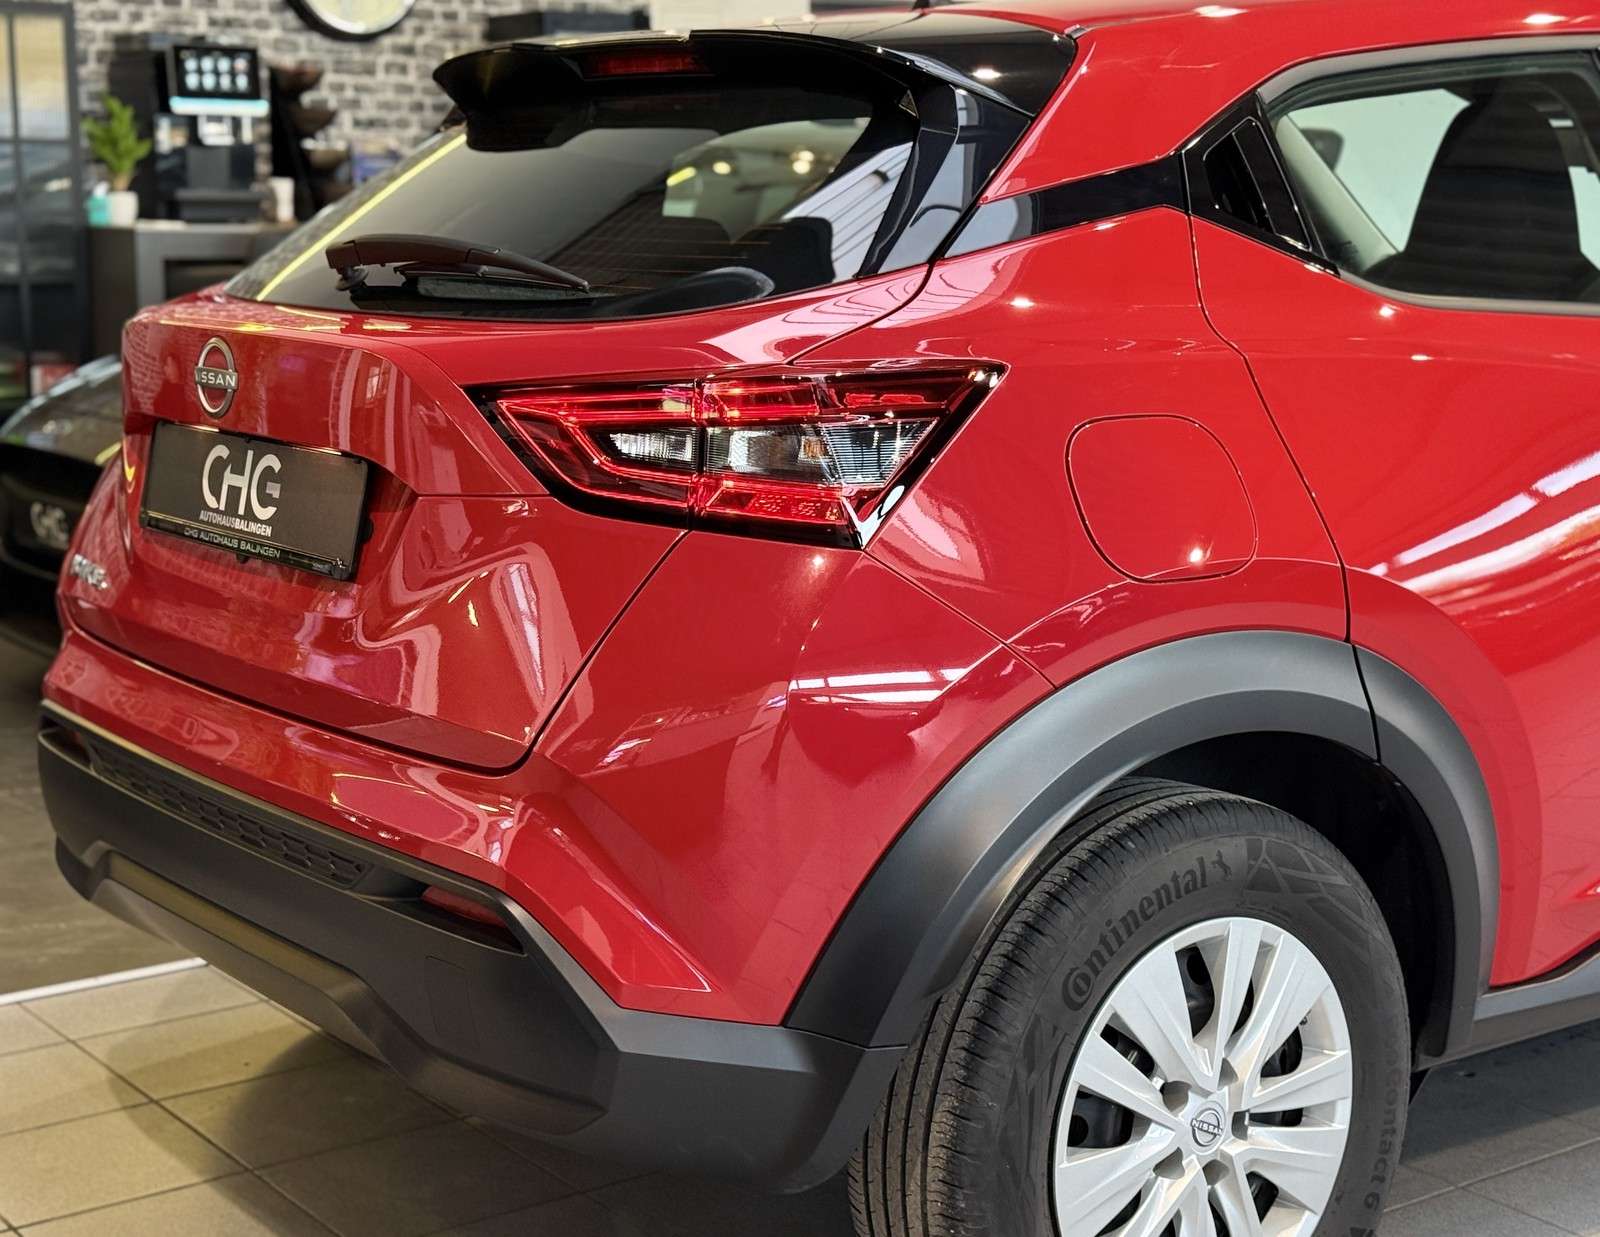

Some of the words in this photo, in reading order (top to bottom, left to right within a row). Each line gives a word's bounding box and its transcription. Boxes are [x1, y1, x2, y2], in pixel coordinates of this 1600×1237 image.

[202, 444, 282, 520] CHG
[200, 510, 272, 537] AUTOHAUSBALINGEN
[200, 531, 239, 548] AUTOHAUS
[240, 541, 280, 558] BALINGEN
[1061, 856, 1208, 1011] Continental
